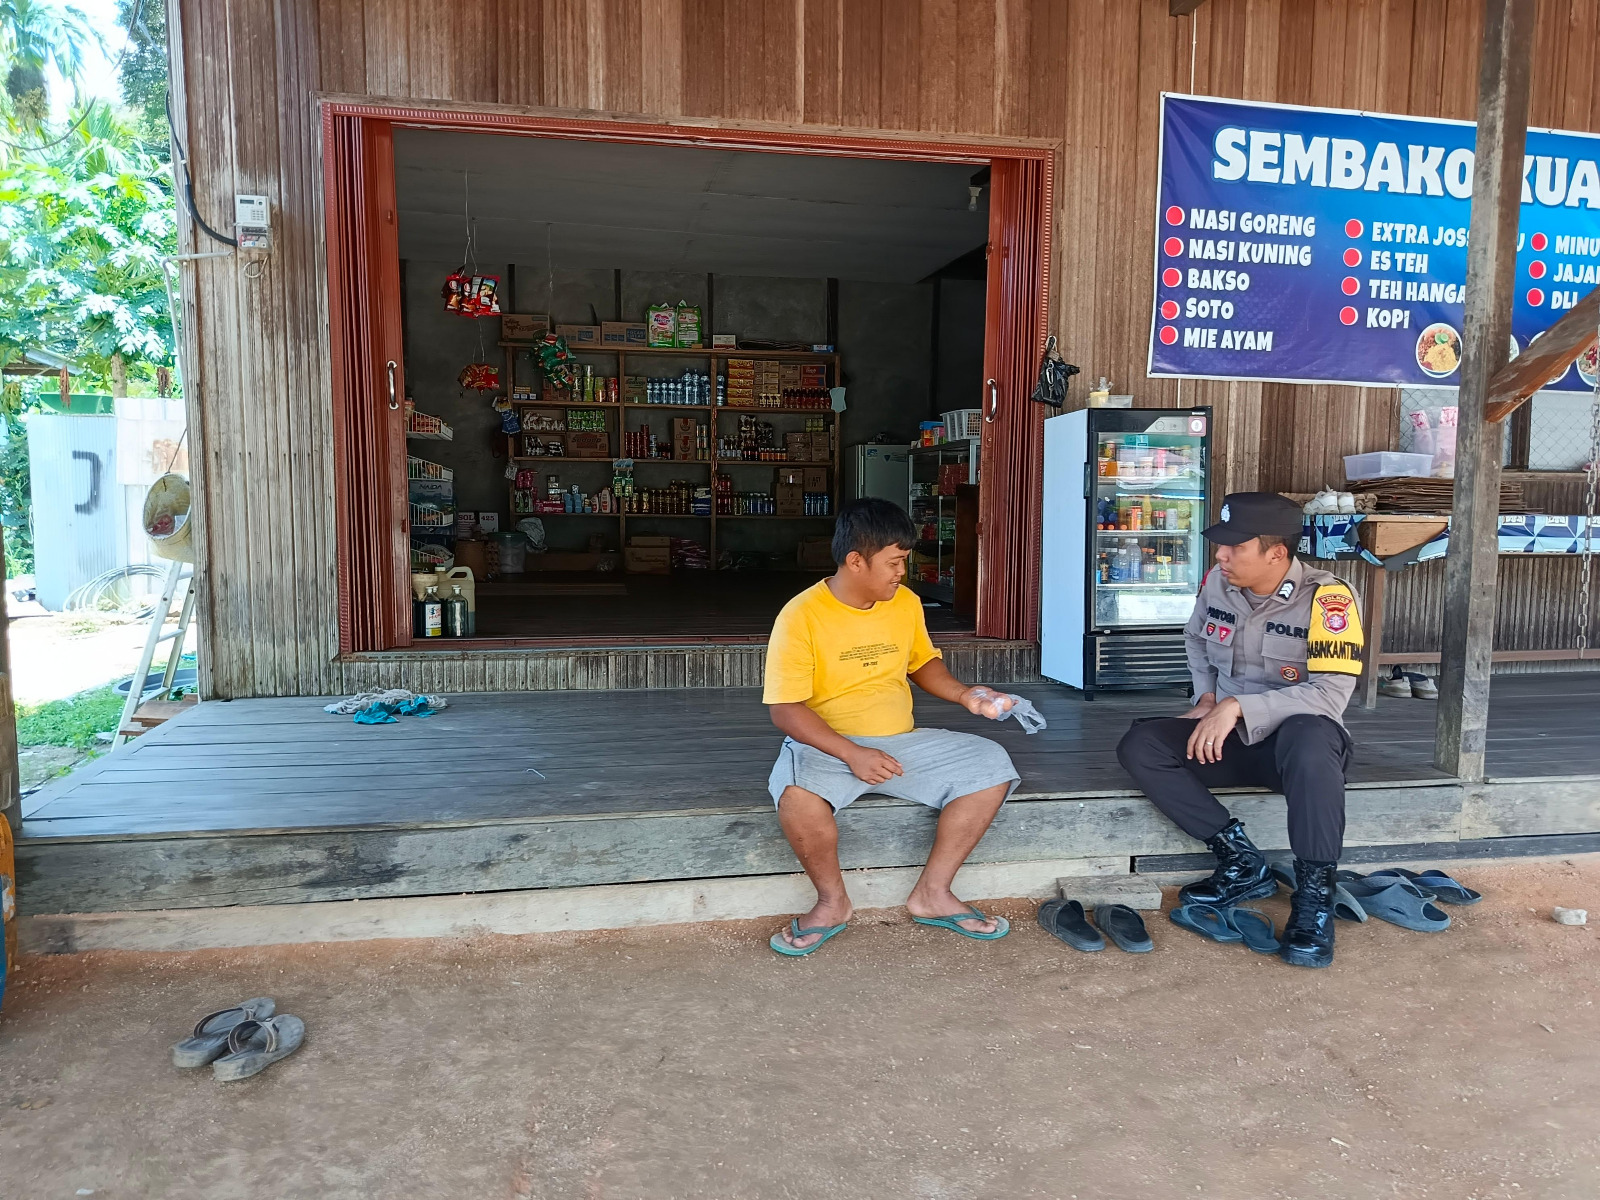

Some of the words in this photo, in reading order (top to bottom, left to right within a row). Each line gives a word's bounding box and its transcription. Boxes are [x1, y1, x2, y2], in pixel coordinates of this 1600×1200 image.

[1214, 127, 1475, 199] SEMBAKO
[1190, 208, 1237, 231] NASI
[1240, 212, 1316, 237] GORENG
[1372, 221, 1430, 244] EXTRA
[1188, 239, 1235, 261] NASI
[1238, 241, 1312, 266] KUNING
[1370, 250, 1391, 271] ES
[1394, 252, 1429, 273] TEH
[1187, 268, 1250, 291] BAKSO
[1369, 279, 1402, 300] TEH
[1185, 297, 1234, 319] SOTO
[1366, 307, 1410, 329] KOPI
[1183, 327, 1218, 349] MIE
[1220, 329, 1273, 351] AYAM
[1266, 621, 1309, 640] POLRI
